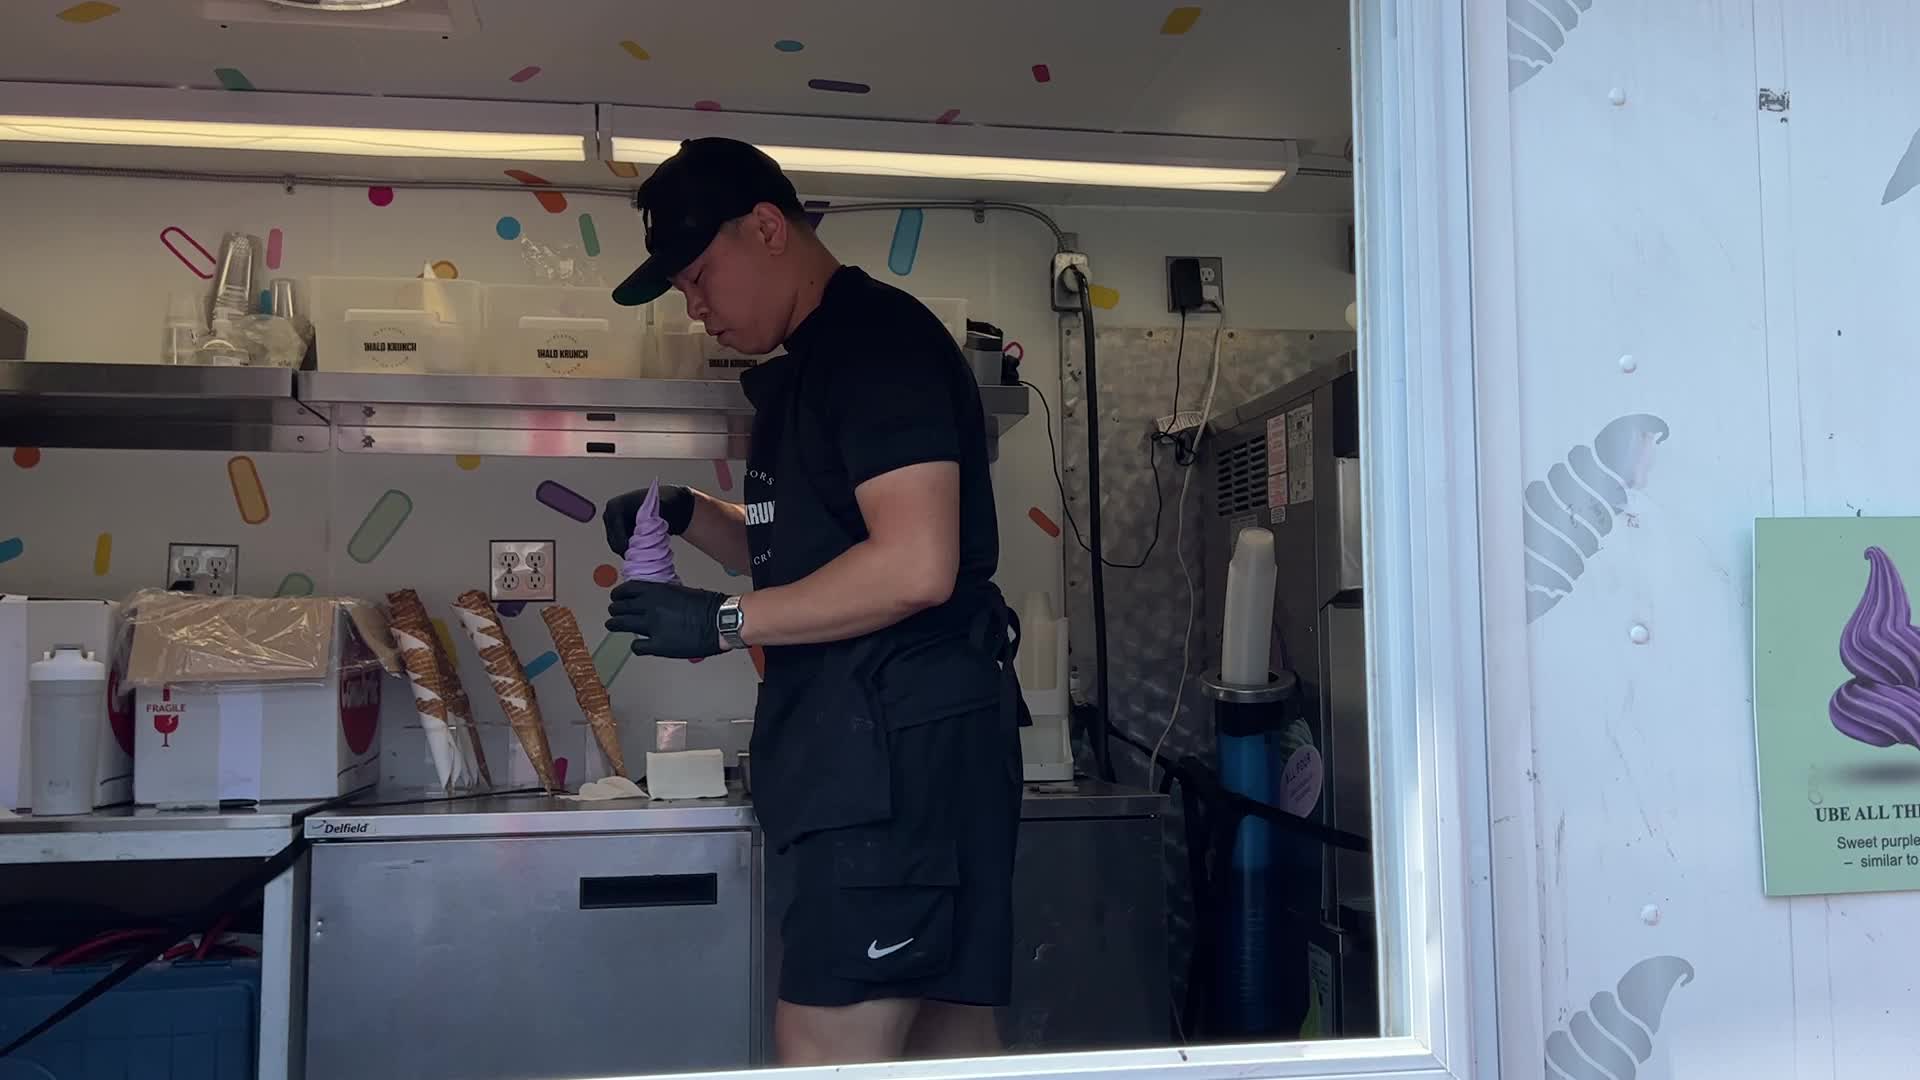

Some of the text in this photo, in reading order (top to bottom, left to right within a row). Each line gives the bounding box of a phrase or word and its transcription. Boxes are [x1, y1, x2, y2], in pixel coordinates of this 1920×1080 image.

[387, 342, 417, 352] KRUNCH
[559, 349, 589, 359] KRUNCH
[146, 703, 187, 713] FRAGILE
[1815, 806, 1851, 822] UBE
[1854, 804, 1890, 820] ALL
[324, 823, 368, 833] Delfield
[1837, 834, 1920, 850] Sweet purple
[1860, 854, 1903, 868] similar
[1906, 853, 1919, 866] to
